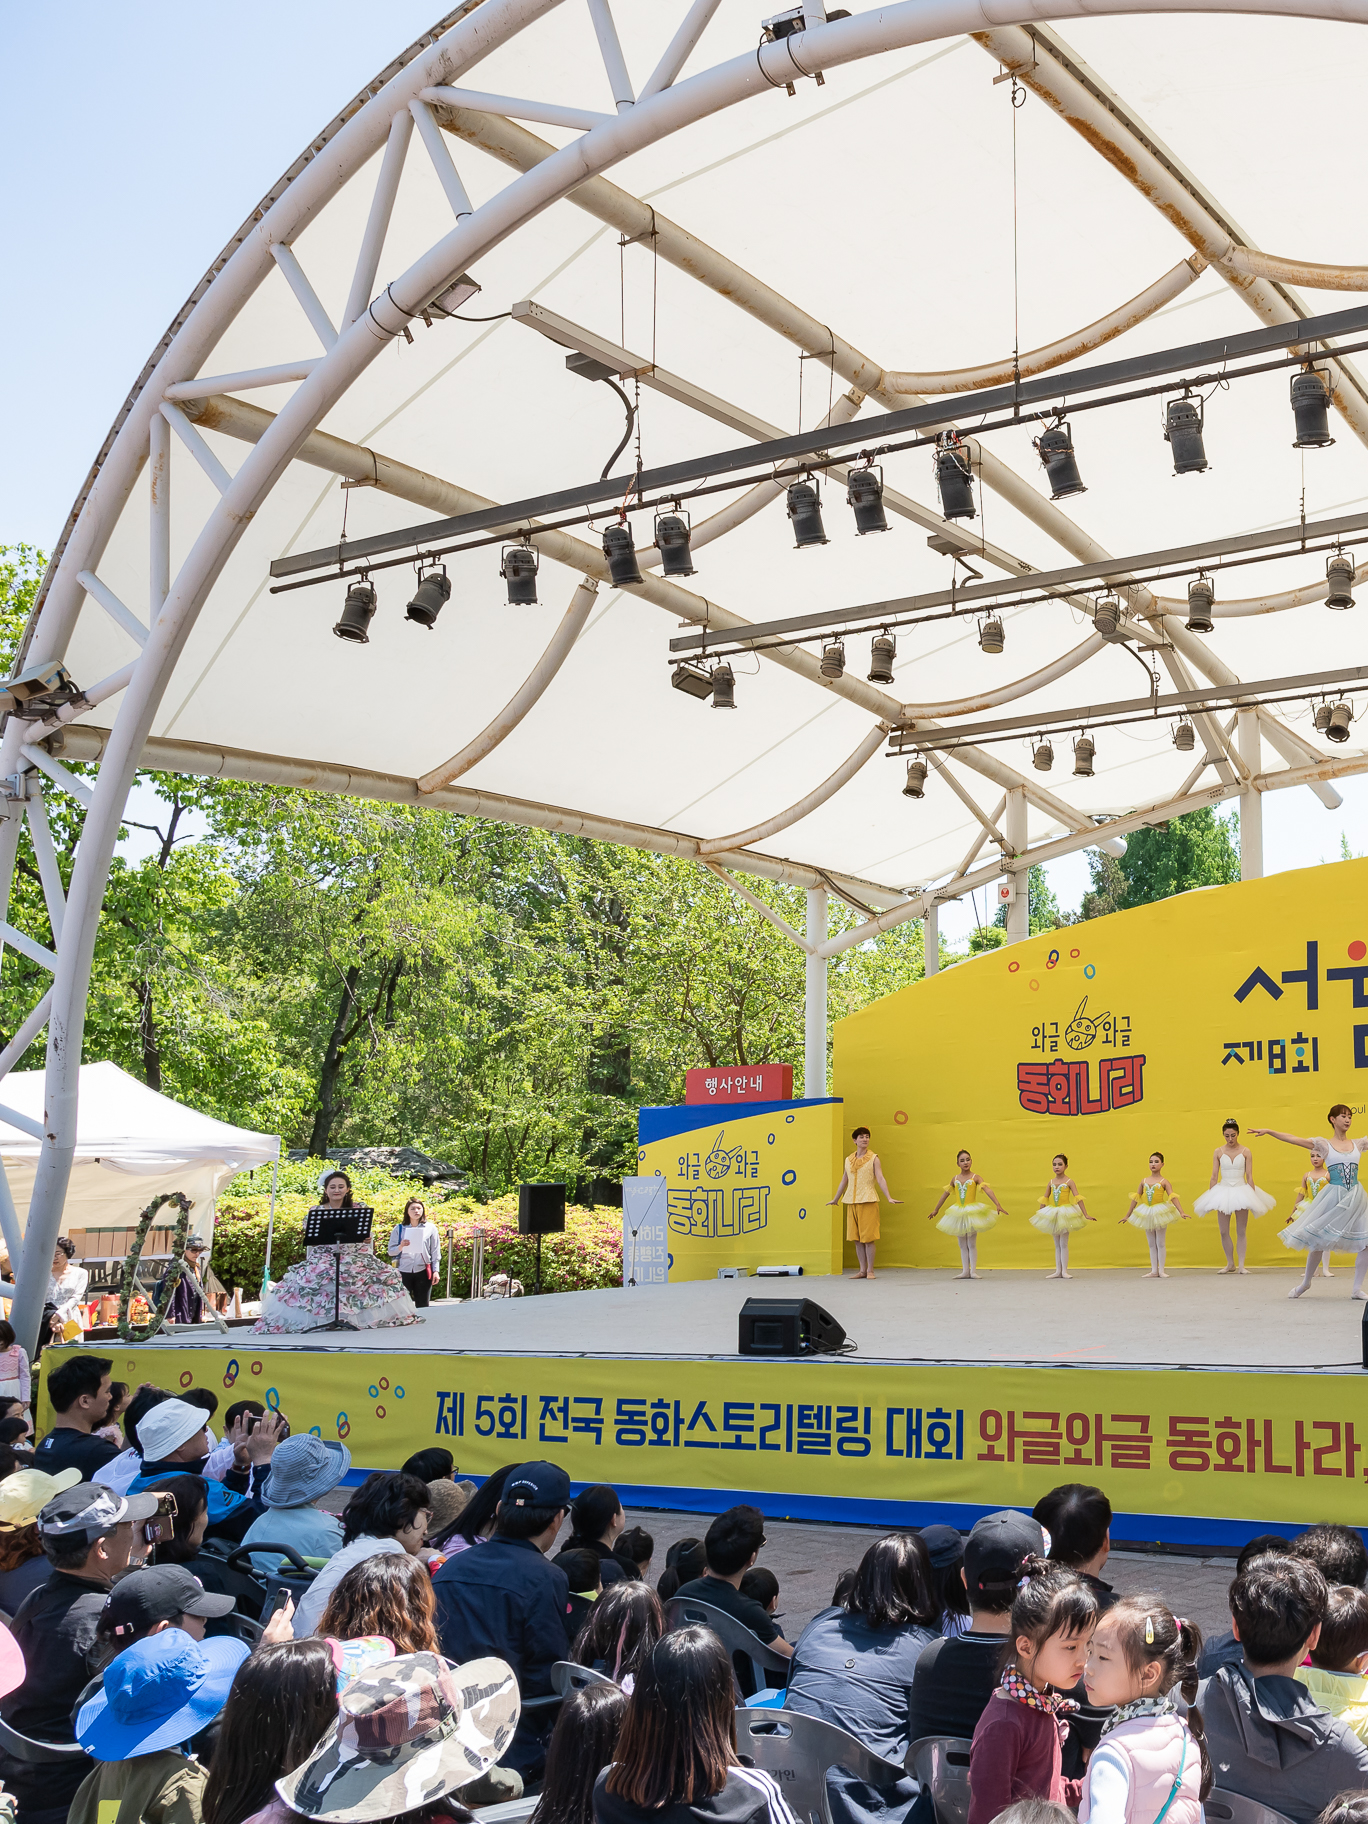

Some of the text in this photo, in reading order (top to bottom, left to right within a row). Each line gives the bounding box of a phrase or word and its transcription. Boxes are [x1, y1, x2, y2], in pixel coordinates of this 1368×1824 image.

[1031, 1016, 1132, 1052] 와글 와글
[1221, 1031, 1319, 1075] 제8회
[705, 1074, 763, 1095] 행사안내
[1017, 1054, 1146, 1116] 동화나라
[678, 1150, 760, 1180] 와글 와글
[667, 1185, 770, 1238] 동화나라
[435, 1391, 465, 1437] 제
[475, 1393, 528, 1440] 5회
[539, 1395, 604, 1445] 전국
[614, 1397, 872, 1458] 동화스토리텔링
[885, 1407, 964, 1461] 대회
[977, 1408, 1153, 1470] 와글와글
